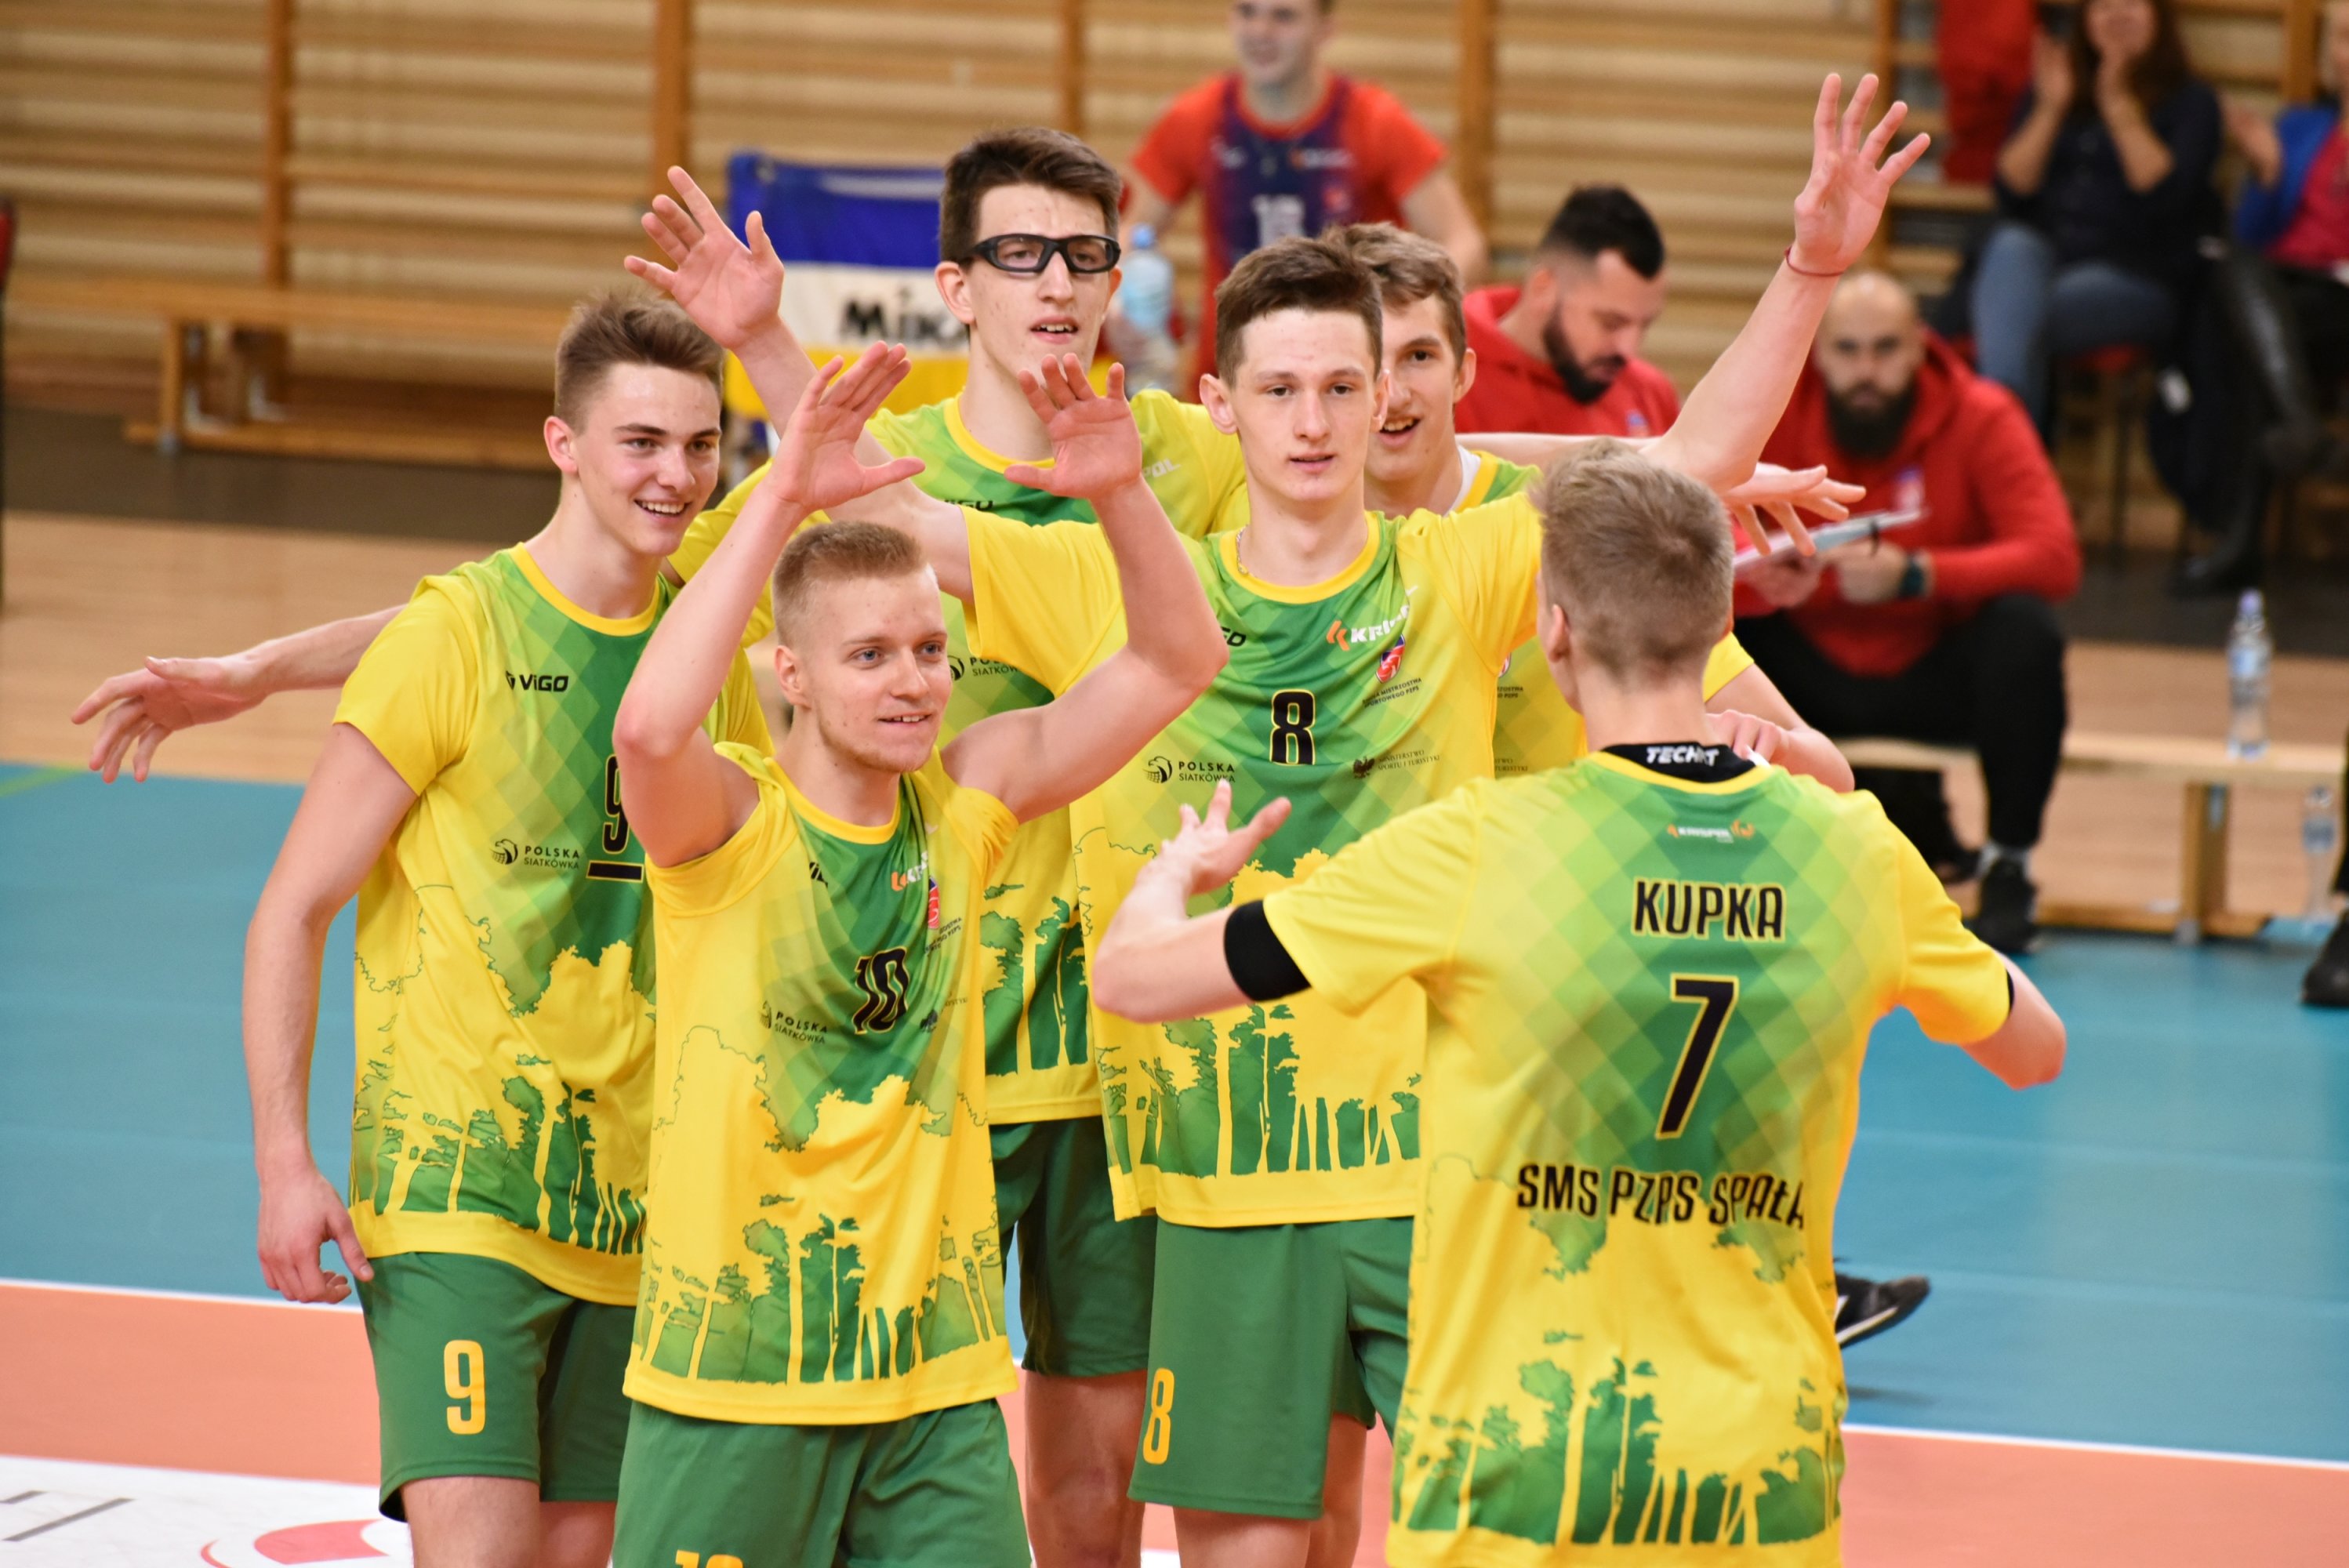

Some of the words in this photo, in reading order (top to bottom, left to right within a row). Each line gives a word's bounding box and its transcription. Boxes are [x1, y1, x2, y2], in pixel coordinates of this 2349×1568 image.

[1269, 689, 1316, 766] 8
[1178, 761, 1235, 773] POLSKA
[601, 754, 630, 854] 9
[524, 856, 579, 869] SIATKÓWKA
[525, 846, 580, 859] POLSKA
[1632, 878, 1785, 942] KUPKA
[775, 1011, 827, 1033] POLSKA
[852, 946, 909, 1034] 10
[1654, 973, 1738, 1140] 7
[1517, 1163, 1600, 1218] SMS
[1610, 1167, 1700, 1225] PZPS
[444, 1339, 486, 1435] 9
[1143, 1368, 1174, 1465] 8
